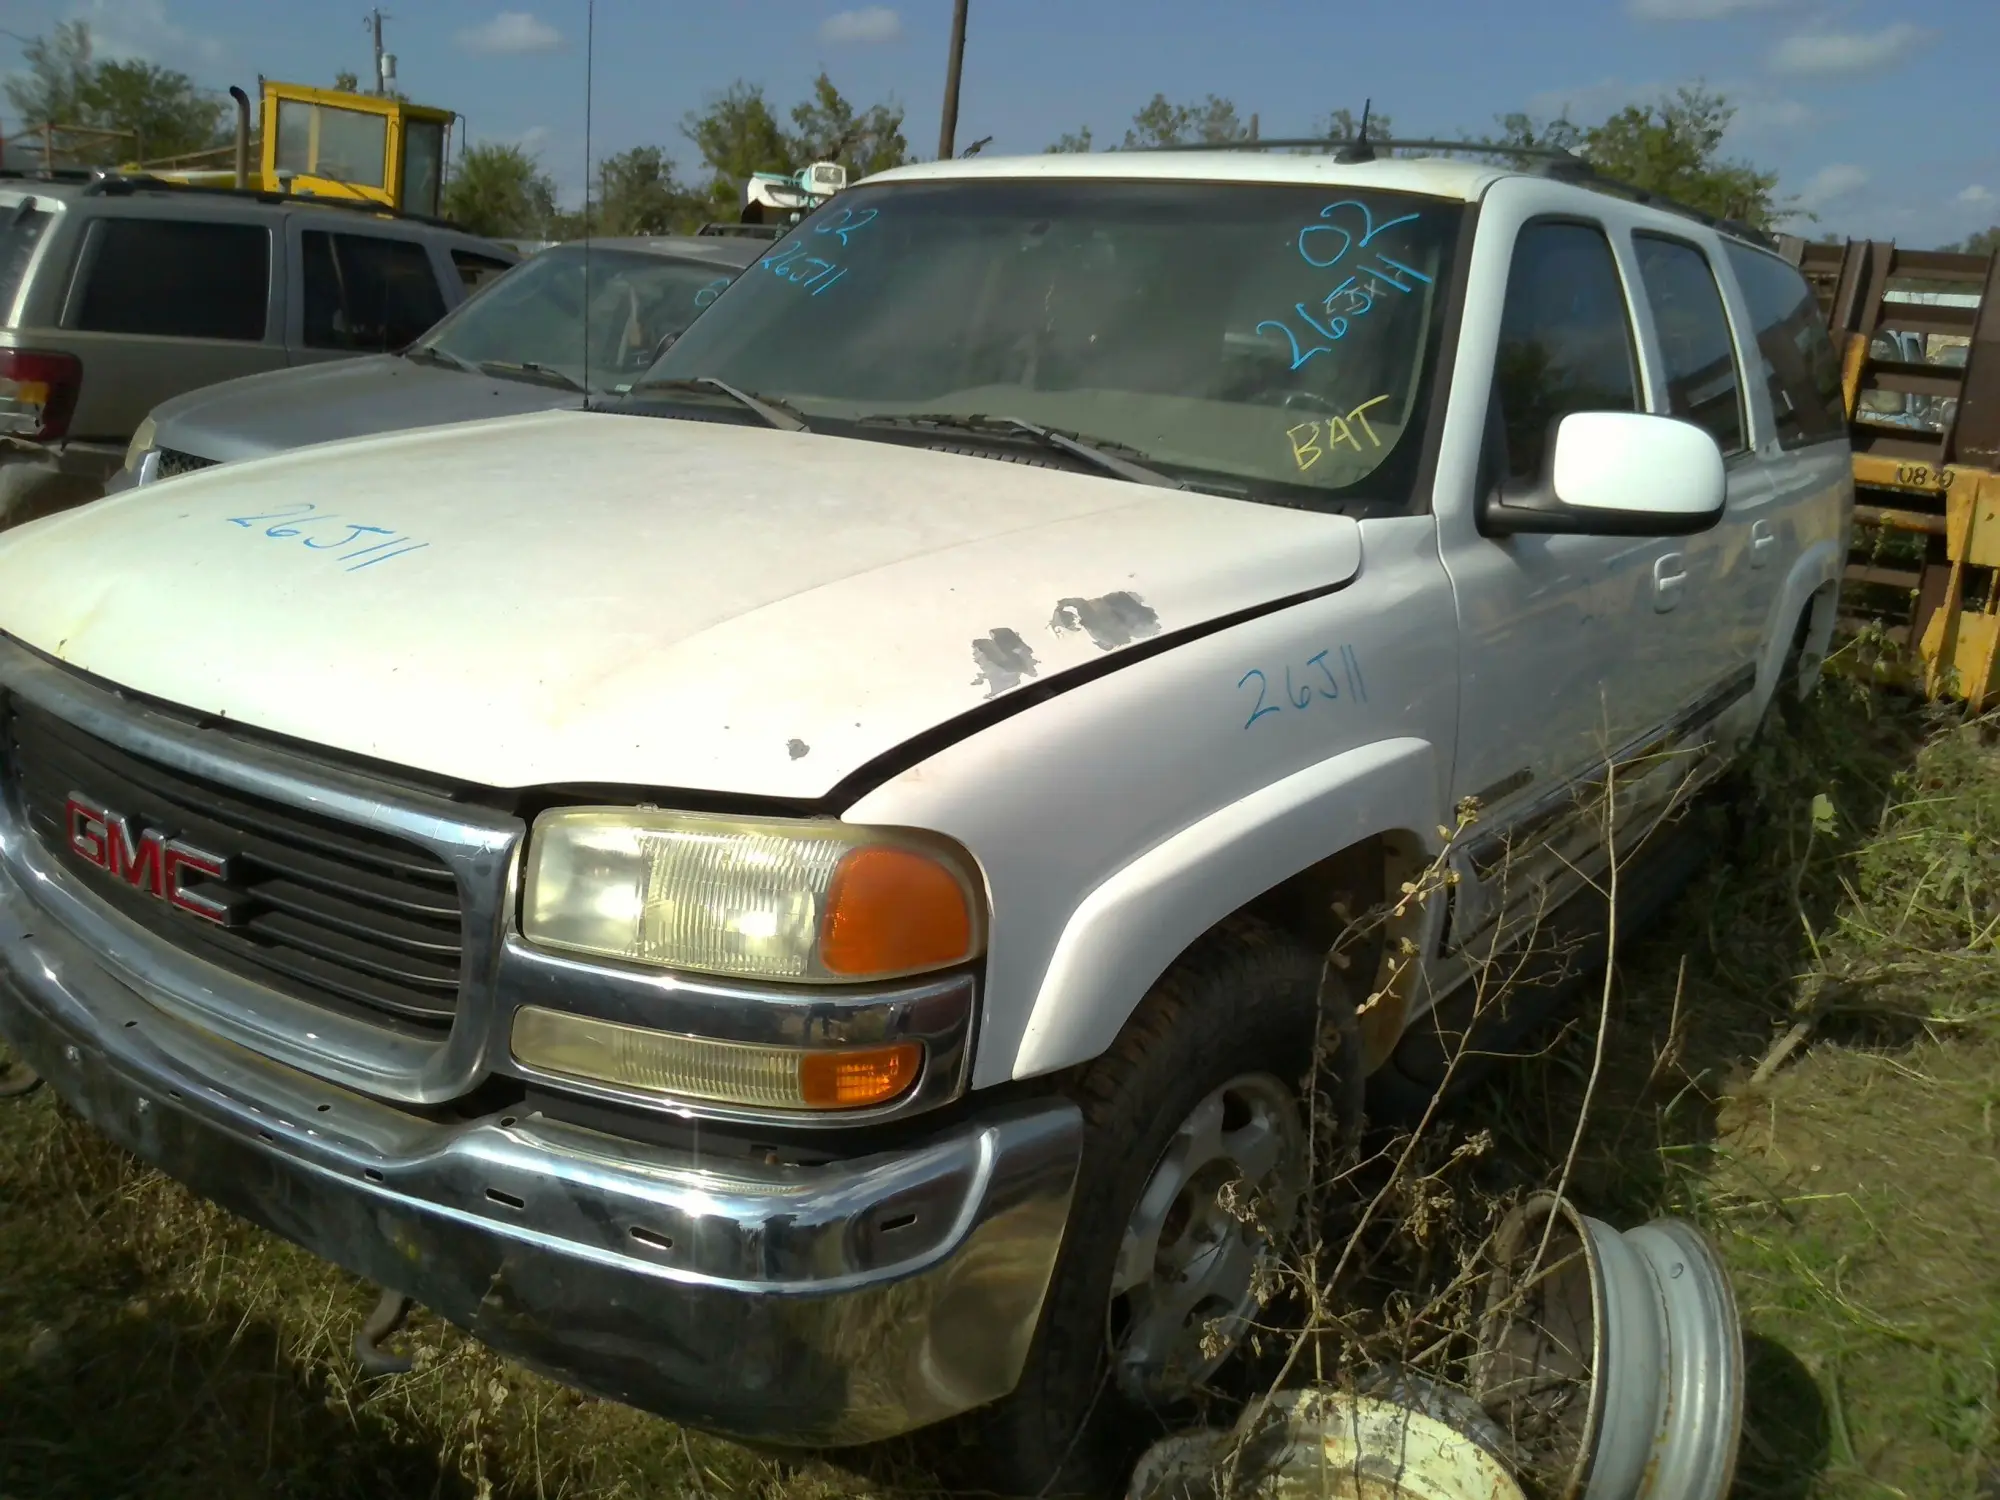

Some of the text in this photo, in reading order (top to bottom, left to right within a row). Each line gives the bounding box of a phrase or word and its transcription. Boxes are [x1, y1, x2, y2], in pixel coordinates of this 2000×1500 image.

[1299, 200, 1420, 267] 02
[1286, 394, 1390, 470] BAT
[1238, 644, 1368, 730] 26J11
[66, 791, 231, 927] GMC
